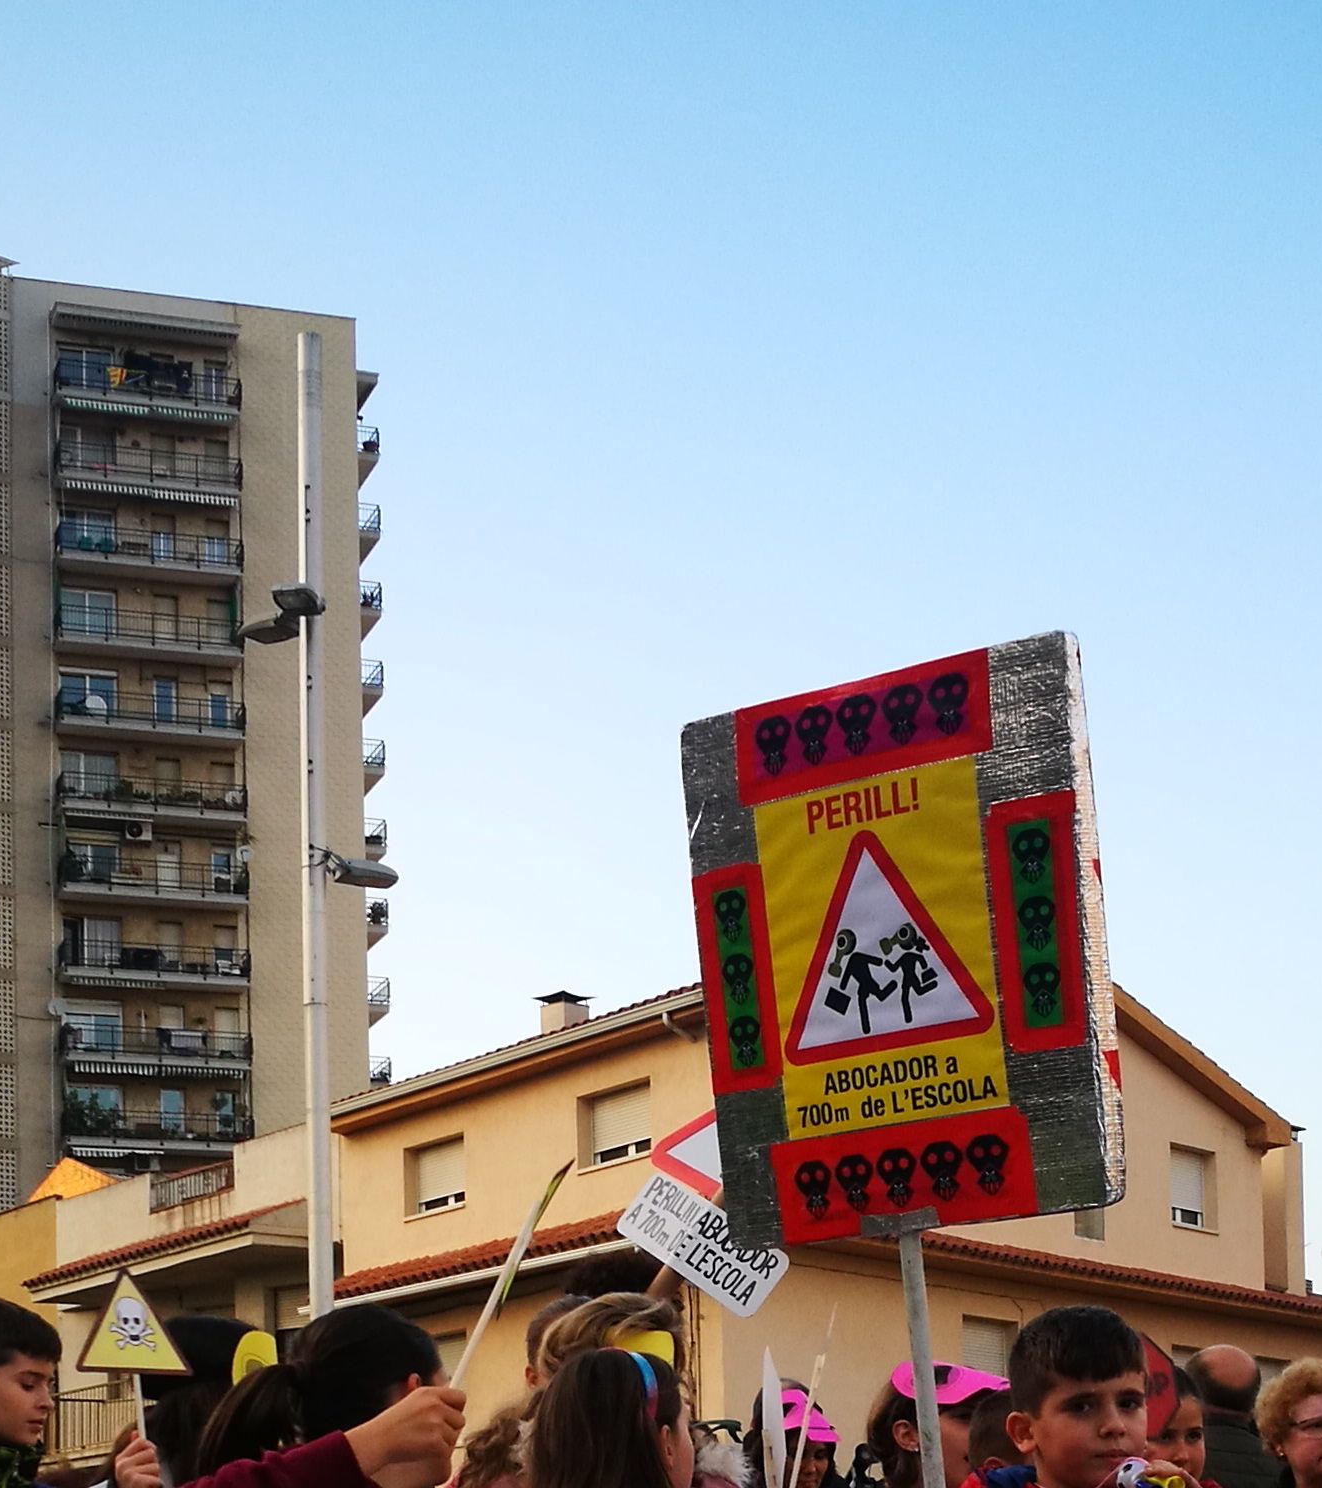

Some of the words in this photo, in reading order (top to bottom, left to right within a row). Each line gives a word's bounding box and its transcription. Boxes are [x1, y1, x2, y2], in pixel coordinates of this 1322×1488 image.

[806, 777, 920, 834] PERILL!
[798, 1102, 850, 1128] 700m
[861, 1095, 885, 1119] de
[892, 1075, 998, 1113] L'ESCOLA
[824, 1055, 938, 1096] ABOCADOR
[946, 1055, 958, 1075] a
[626, 1203, 643, 1225] A
[685, 1242, 757, 1306] L'ESCOLA
